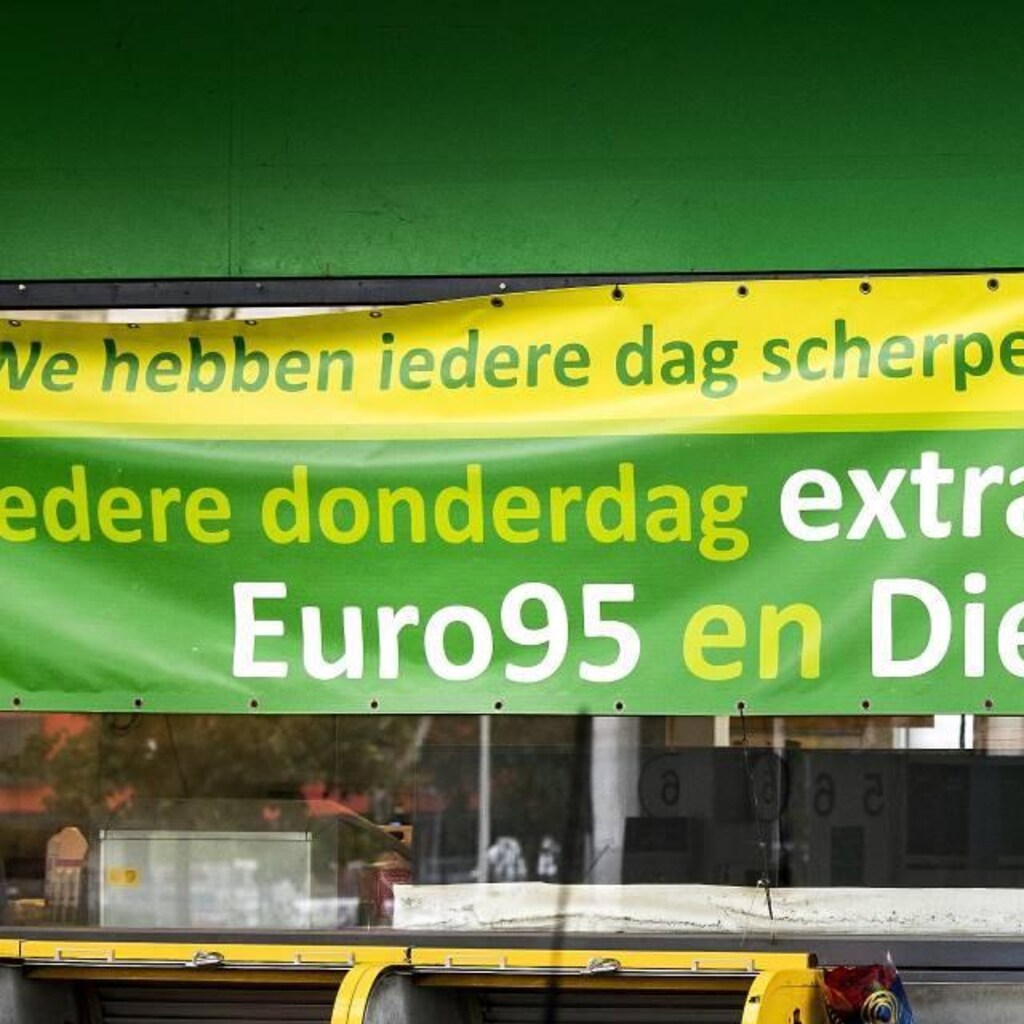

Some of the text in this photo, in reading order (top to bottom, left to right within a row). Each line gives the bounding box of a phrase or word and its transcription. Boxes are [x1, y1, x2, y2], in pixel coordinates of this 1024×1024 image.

[102, 335, 353, 394] hebben
[381, 328, 591, 391] iedere
[614, 323, 739, 398] dag
[261, 462, 749, 561] donderdag
[232, 582, 641, 684] Euro95
[682, 602, 823, 681] en
